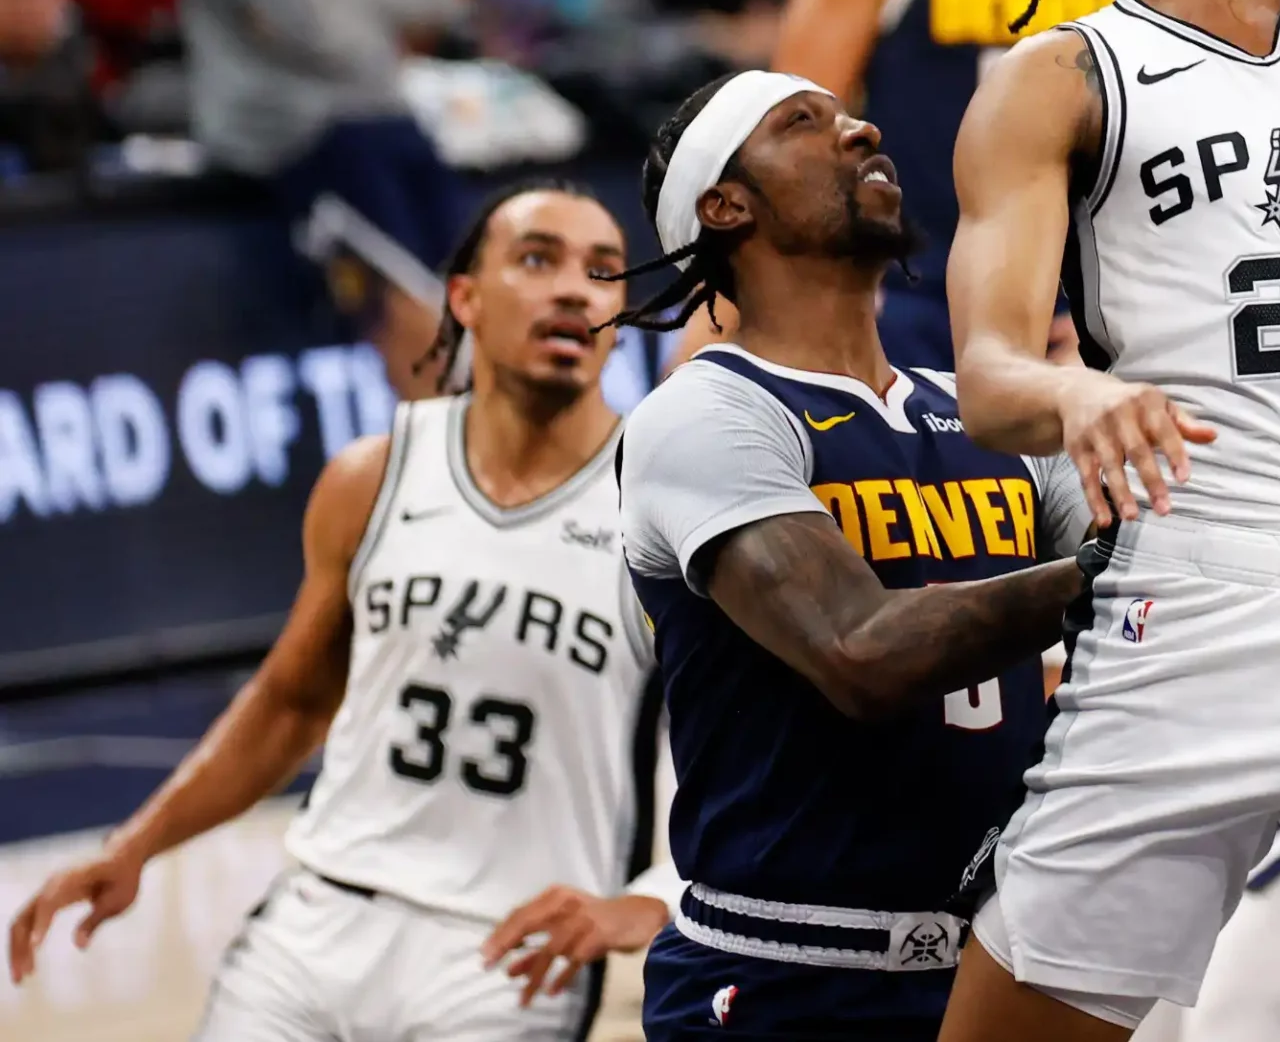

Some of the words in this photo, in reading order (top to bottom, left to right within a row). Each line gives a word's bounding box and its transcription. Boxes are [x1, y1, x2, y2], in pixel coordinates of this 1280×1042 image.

[177, 354, 297, 494] OF
[366, 575, 614, 677] SPURS
[389, 683, 536, 797] 33
